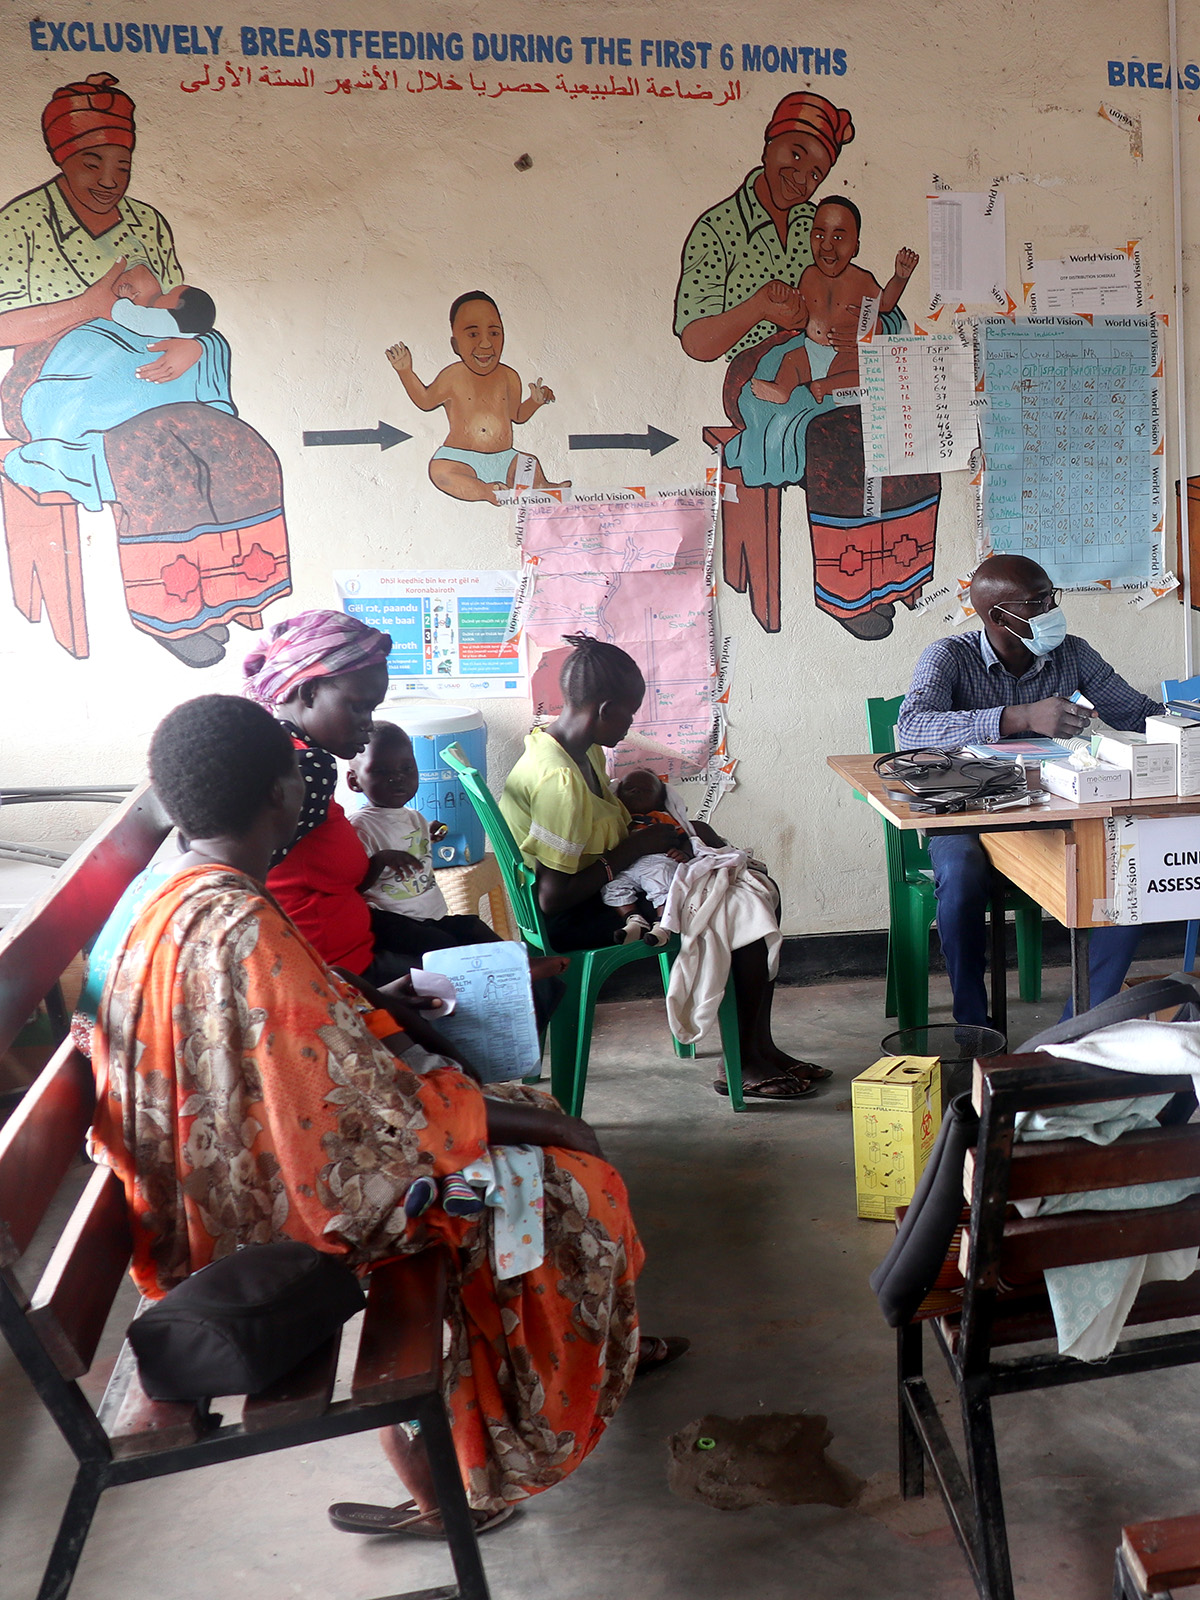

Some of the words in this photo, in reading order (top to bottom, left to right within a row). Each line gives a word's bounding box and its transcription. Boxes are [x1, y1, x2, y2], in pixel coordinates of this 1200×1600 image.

[30, 21, 223, 55] EXCLUSIVELY
[241, 27, 464, 62] BREASTFEEDING
[473, 33, 573, 64] DURING
[581, 36, 632, 67] THE
[641, 40, 712, 69] FIRST
[721, 43, 734, 70] 6
[743, 44, 847, 76] MONTHS
[180, 61, 252, 93] الأولى
[258, 65, 314, 88] الستة
[323, 64, 398, 94] الأشهر
[406, 68, 463, 94] خلال
[469, 73, 550, 98] حصريا
[556, 73, 640, 100] الطبيعية
[647, 80, 743, 106] الرضاعة
[1069, 253, 1097, 262] World
[1098, 253, 1124, 261] Vision
[1027, 317, 1055, 325] World
[1057, 317, 1083, 326] Vision
[891, 347, 908, 356] OTP
[926, 346, 949, 354] TSFP
[574, 493, 604, 502] World
[606, 493, 635, 501] Vision
